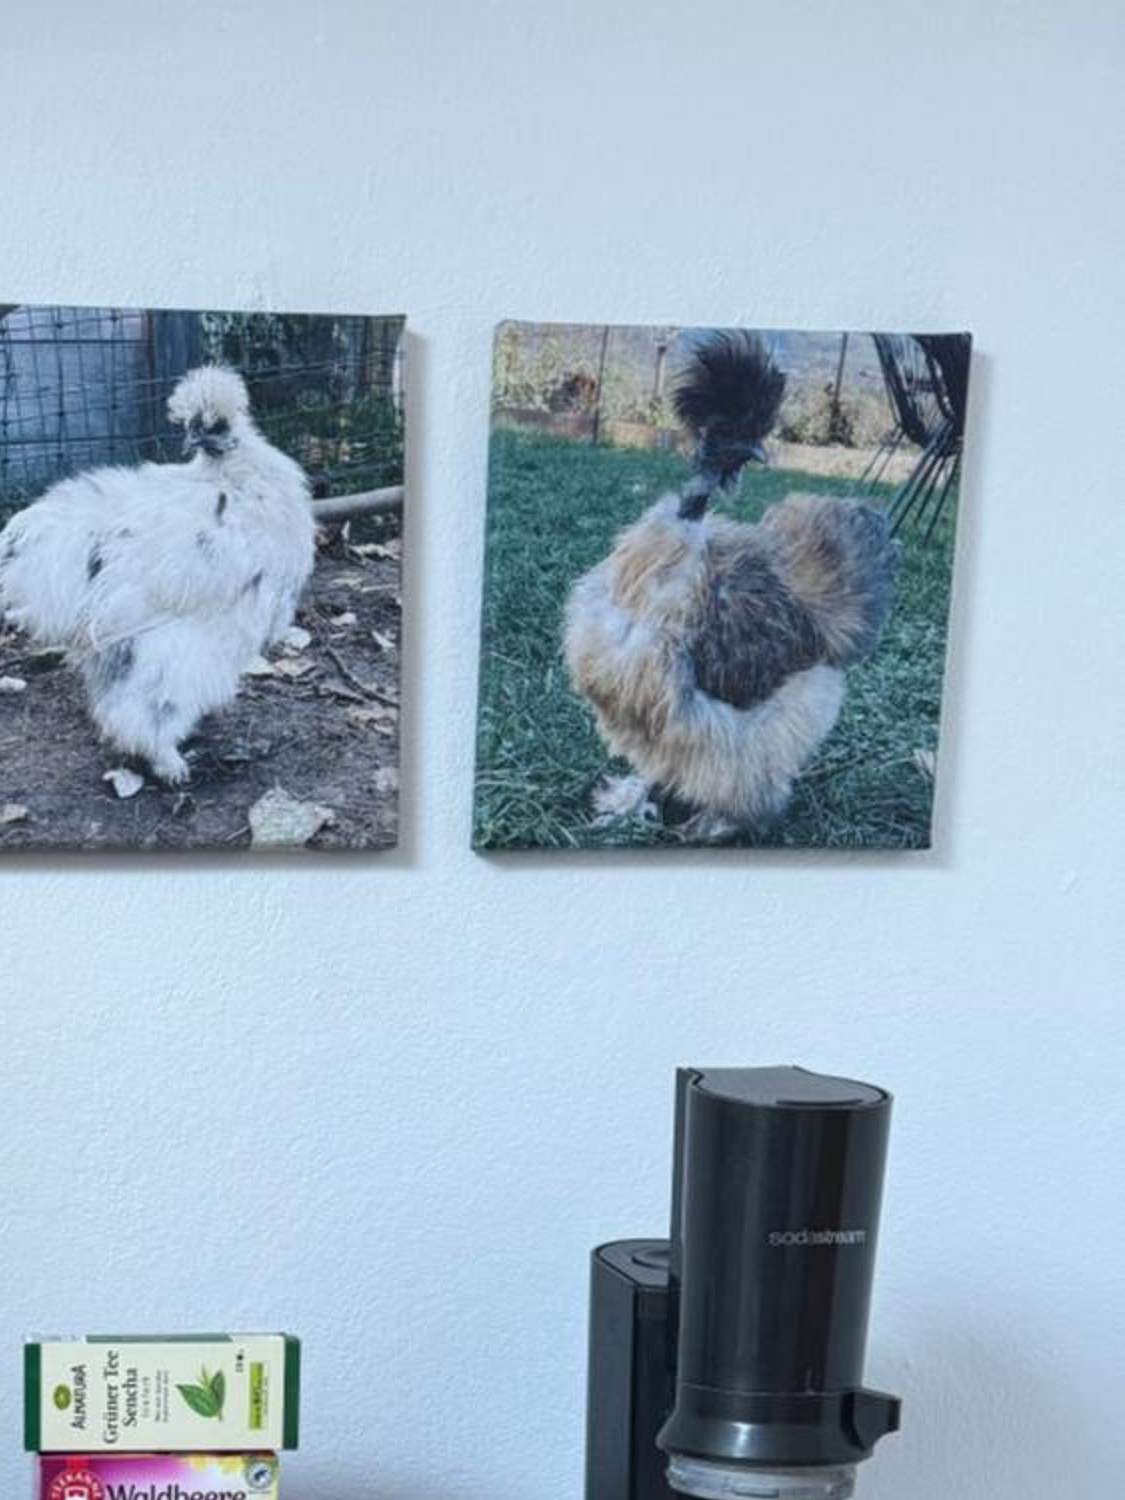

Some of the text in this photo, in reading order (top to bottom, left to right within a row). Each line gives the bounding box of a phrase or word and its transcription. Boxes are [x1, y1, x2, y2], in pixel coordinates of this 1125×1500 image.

[768, 1228, 866, 1247] sodastream
[103, 1350, 119, 1444] Grüner Tee
[121, 1367, 138, 1428] Sencha
